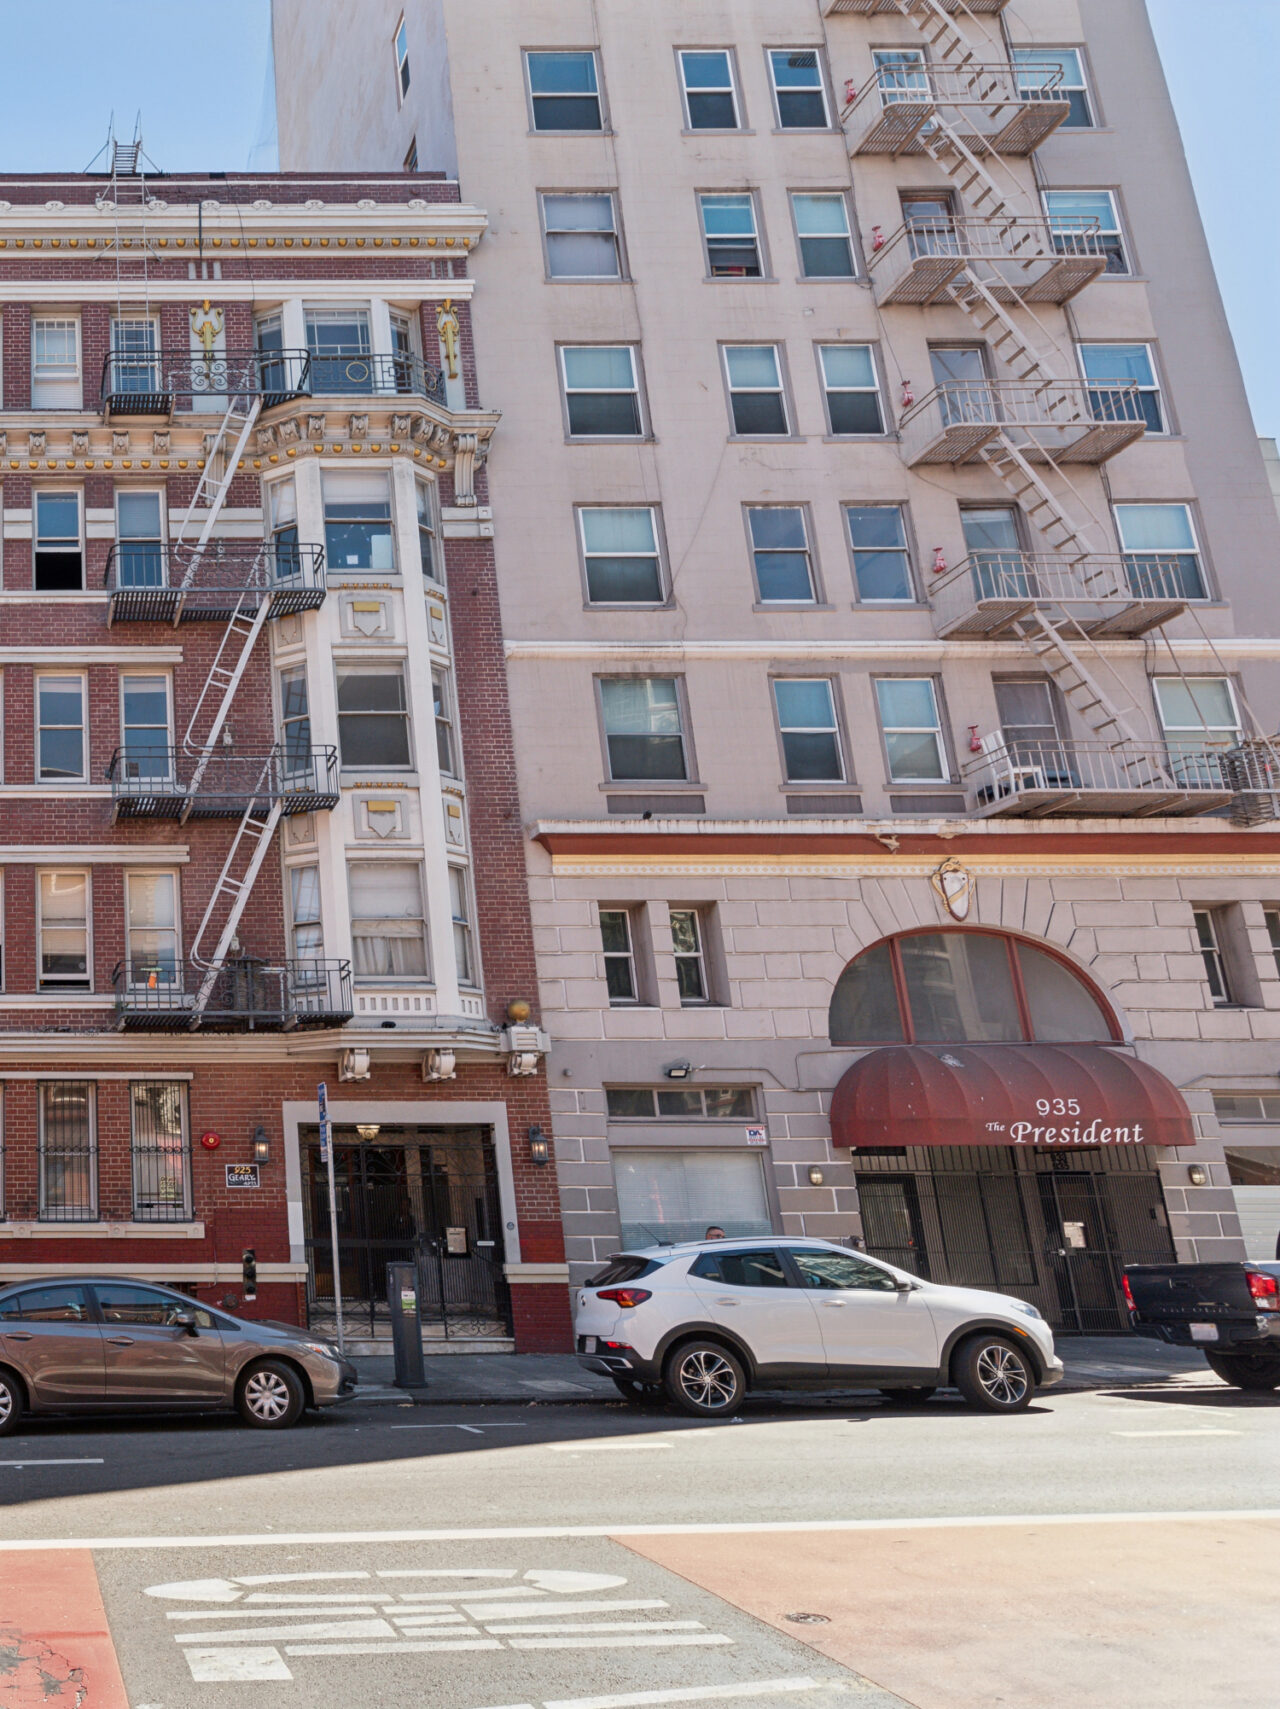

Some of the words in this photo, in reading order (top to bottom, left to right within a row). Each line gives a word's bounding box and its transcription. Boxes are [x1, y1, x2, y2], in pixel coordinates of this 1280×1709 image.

[1035, 1098, 1081, 1116] 935
[985, 1121, 1006, 1132] The
[1009, 1118, 1144, 1144] President
[233, 1166, 252, 1175] 925
